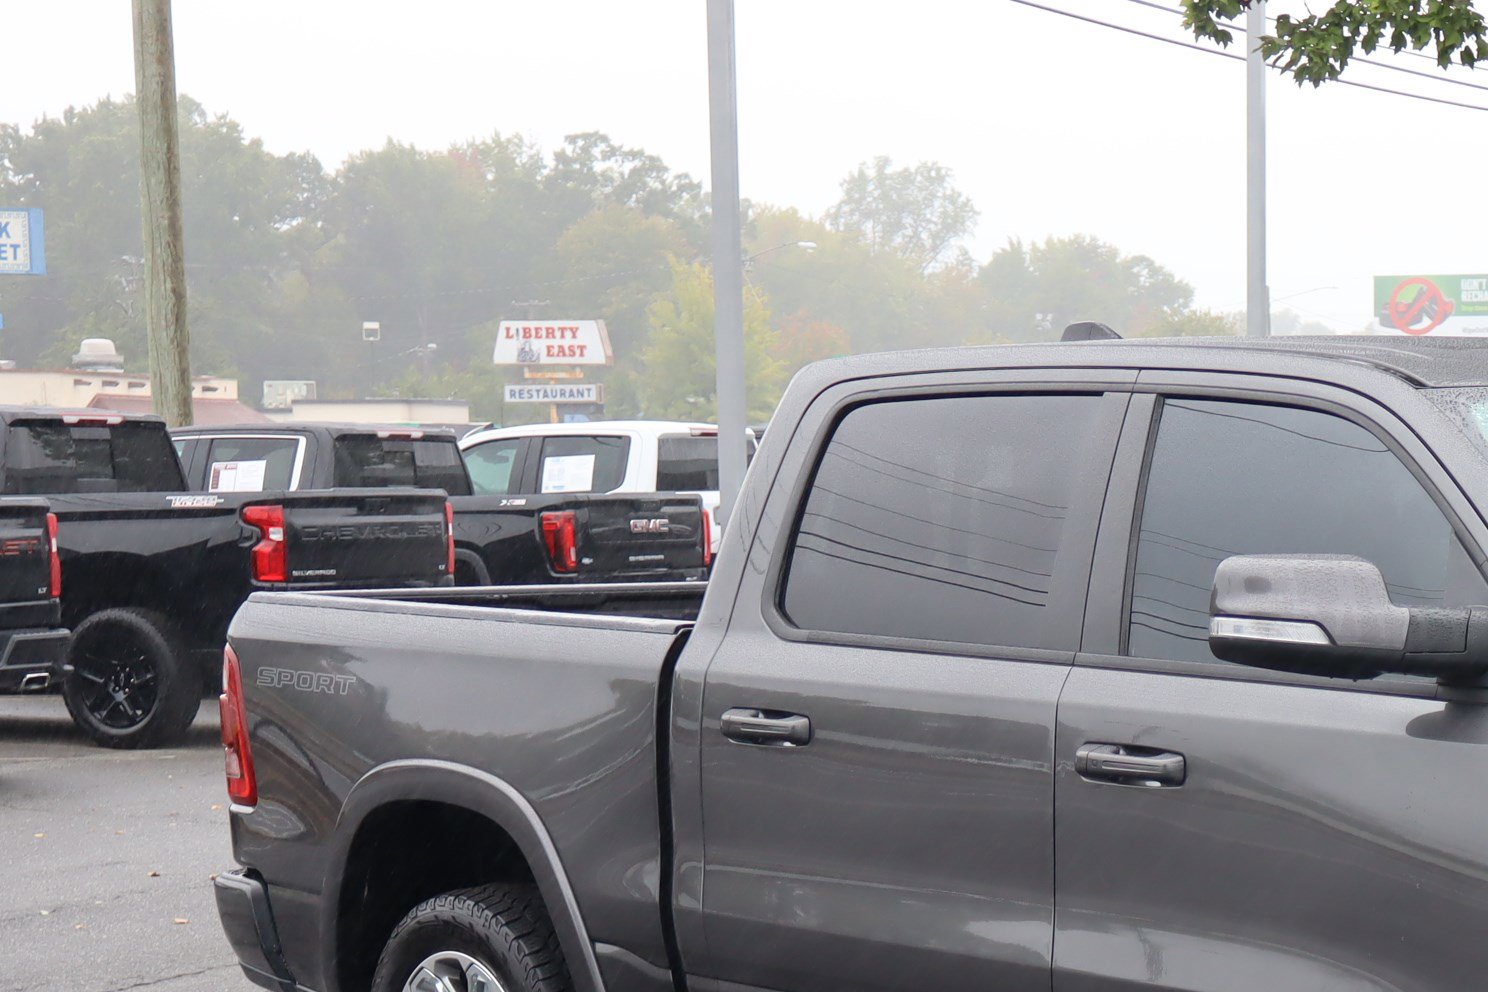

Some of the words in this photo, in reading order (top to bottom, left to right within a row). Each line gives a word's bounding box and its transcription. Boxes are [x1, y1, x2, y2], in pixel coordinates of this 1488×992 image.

[546, 344, 588, 358] EAST
[508, 387, 593, 400] RESTAURANT
[629, 518, 670, 534] GMC
[256, 666, 357, 696] SPORT
